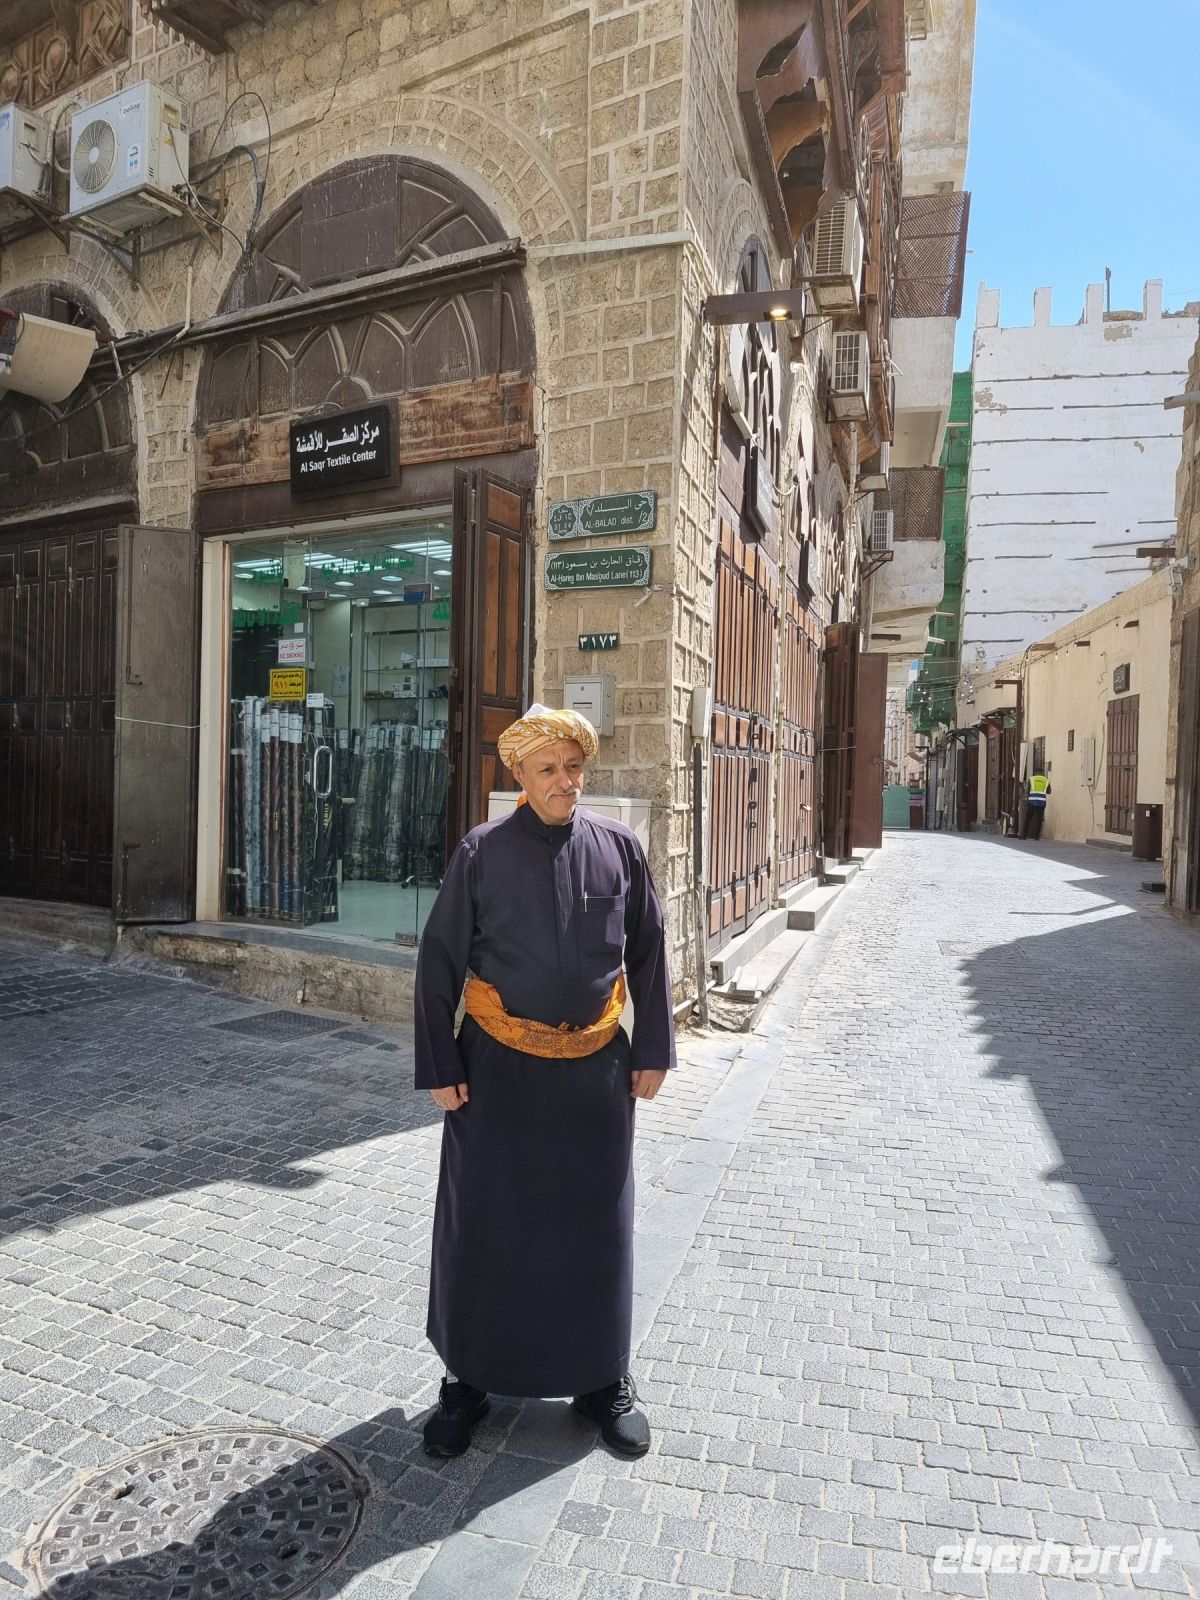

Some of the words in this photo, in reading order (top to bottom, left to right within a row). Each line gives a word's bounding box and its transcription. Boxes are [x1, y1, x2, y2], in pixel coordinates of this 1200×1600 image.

[324, 424, 359, 452] الصقر
[360, 420, 379, 445] مركز
[296, 430, 323, 453] للأقمشة
[300, 462, 308, 473] Al
[309, 460, 325, 472] Saqr
[327, 454, 351, 467] Textile
[352, 450, 377, 463] Center
[584, 518, 617, 530] AL-BALAD
[600, 555, 623, 568] الحارث
[625, 555, 643, 567] زقاق
[575, 573, 585, 581] Ibn
[580, 634, 617, 649] ٣١٧٣
